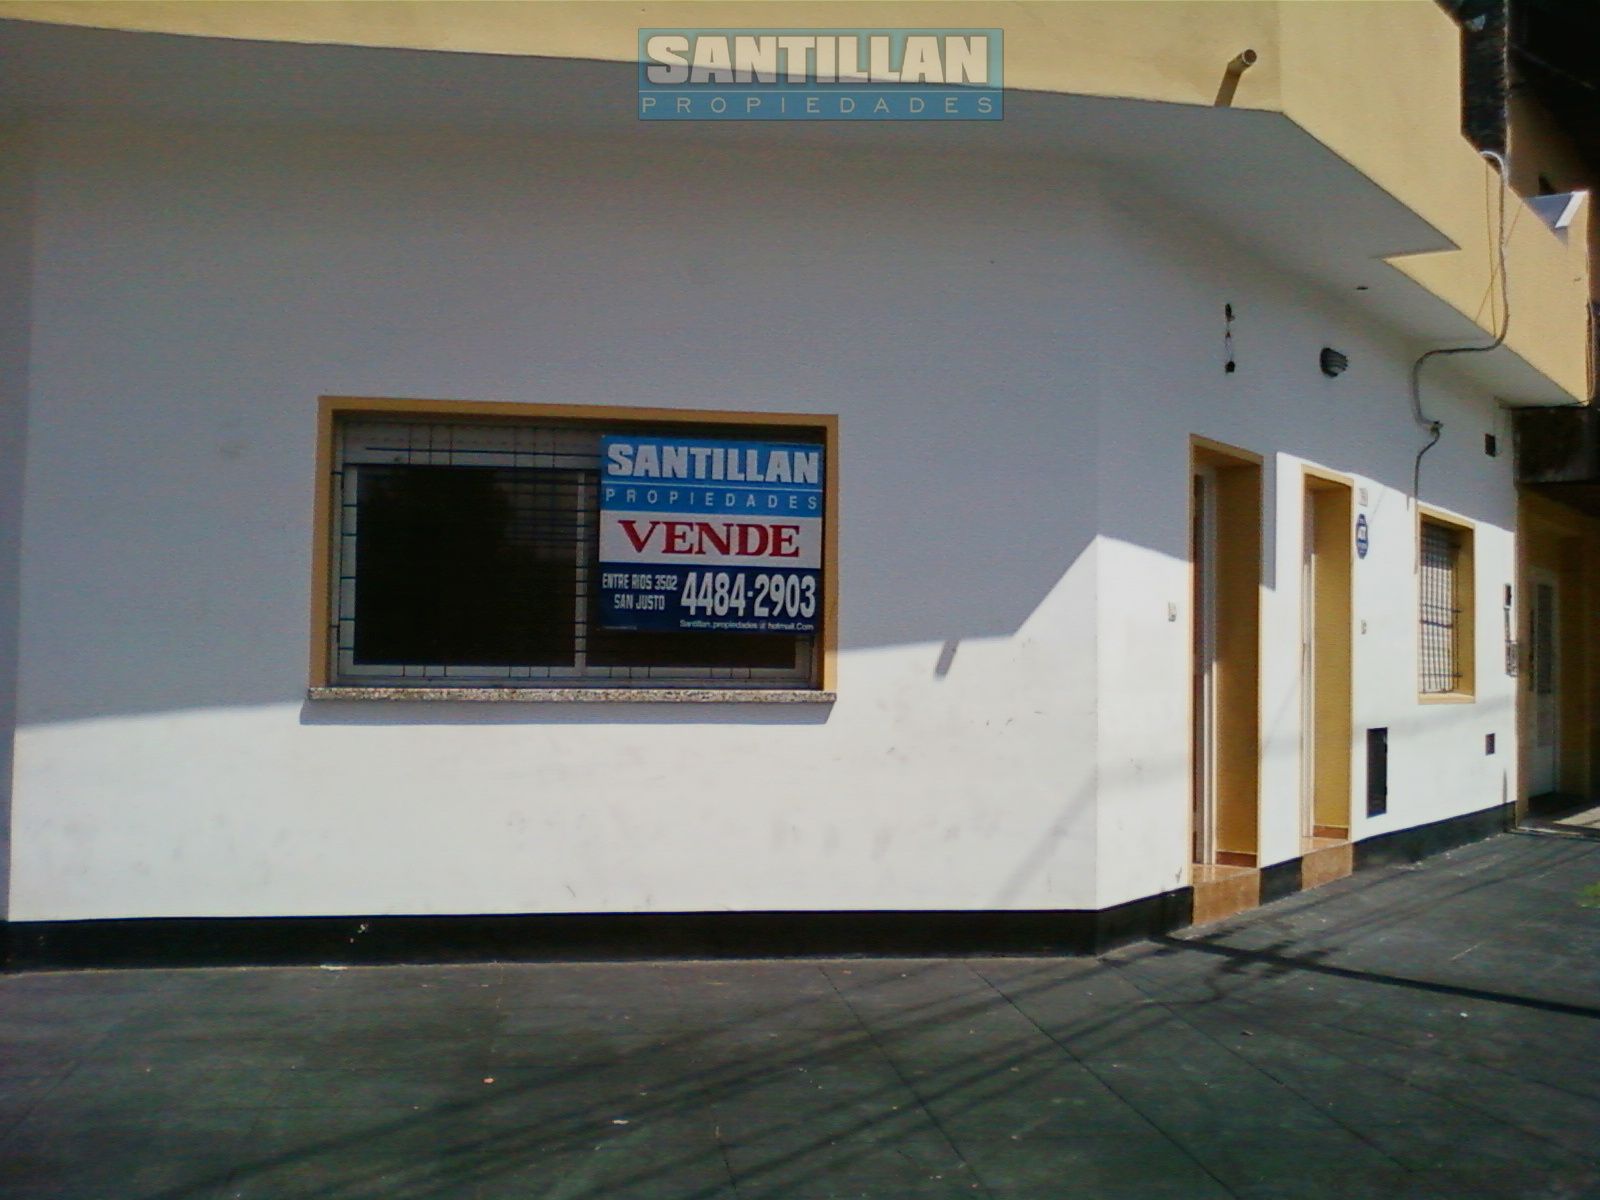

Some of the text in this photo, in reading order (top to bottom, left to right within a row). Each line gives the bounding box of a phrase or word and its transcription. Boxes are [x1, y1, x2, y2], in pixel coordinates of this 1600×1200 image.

[607, 443, 819, 484] SANTILLAN
[605, 488, 818, 510] PROPIEDADES
[617, 519, 801, 558] VENDE
[602, 573, 630, 590] ENTRE
[631, 574, 653, 590] RIOS
[680, 571, 817, 618] 4484-2903
[614, 594, 666, 611] SAN JUSTO
